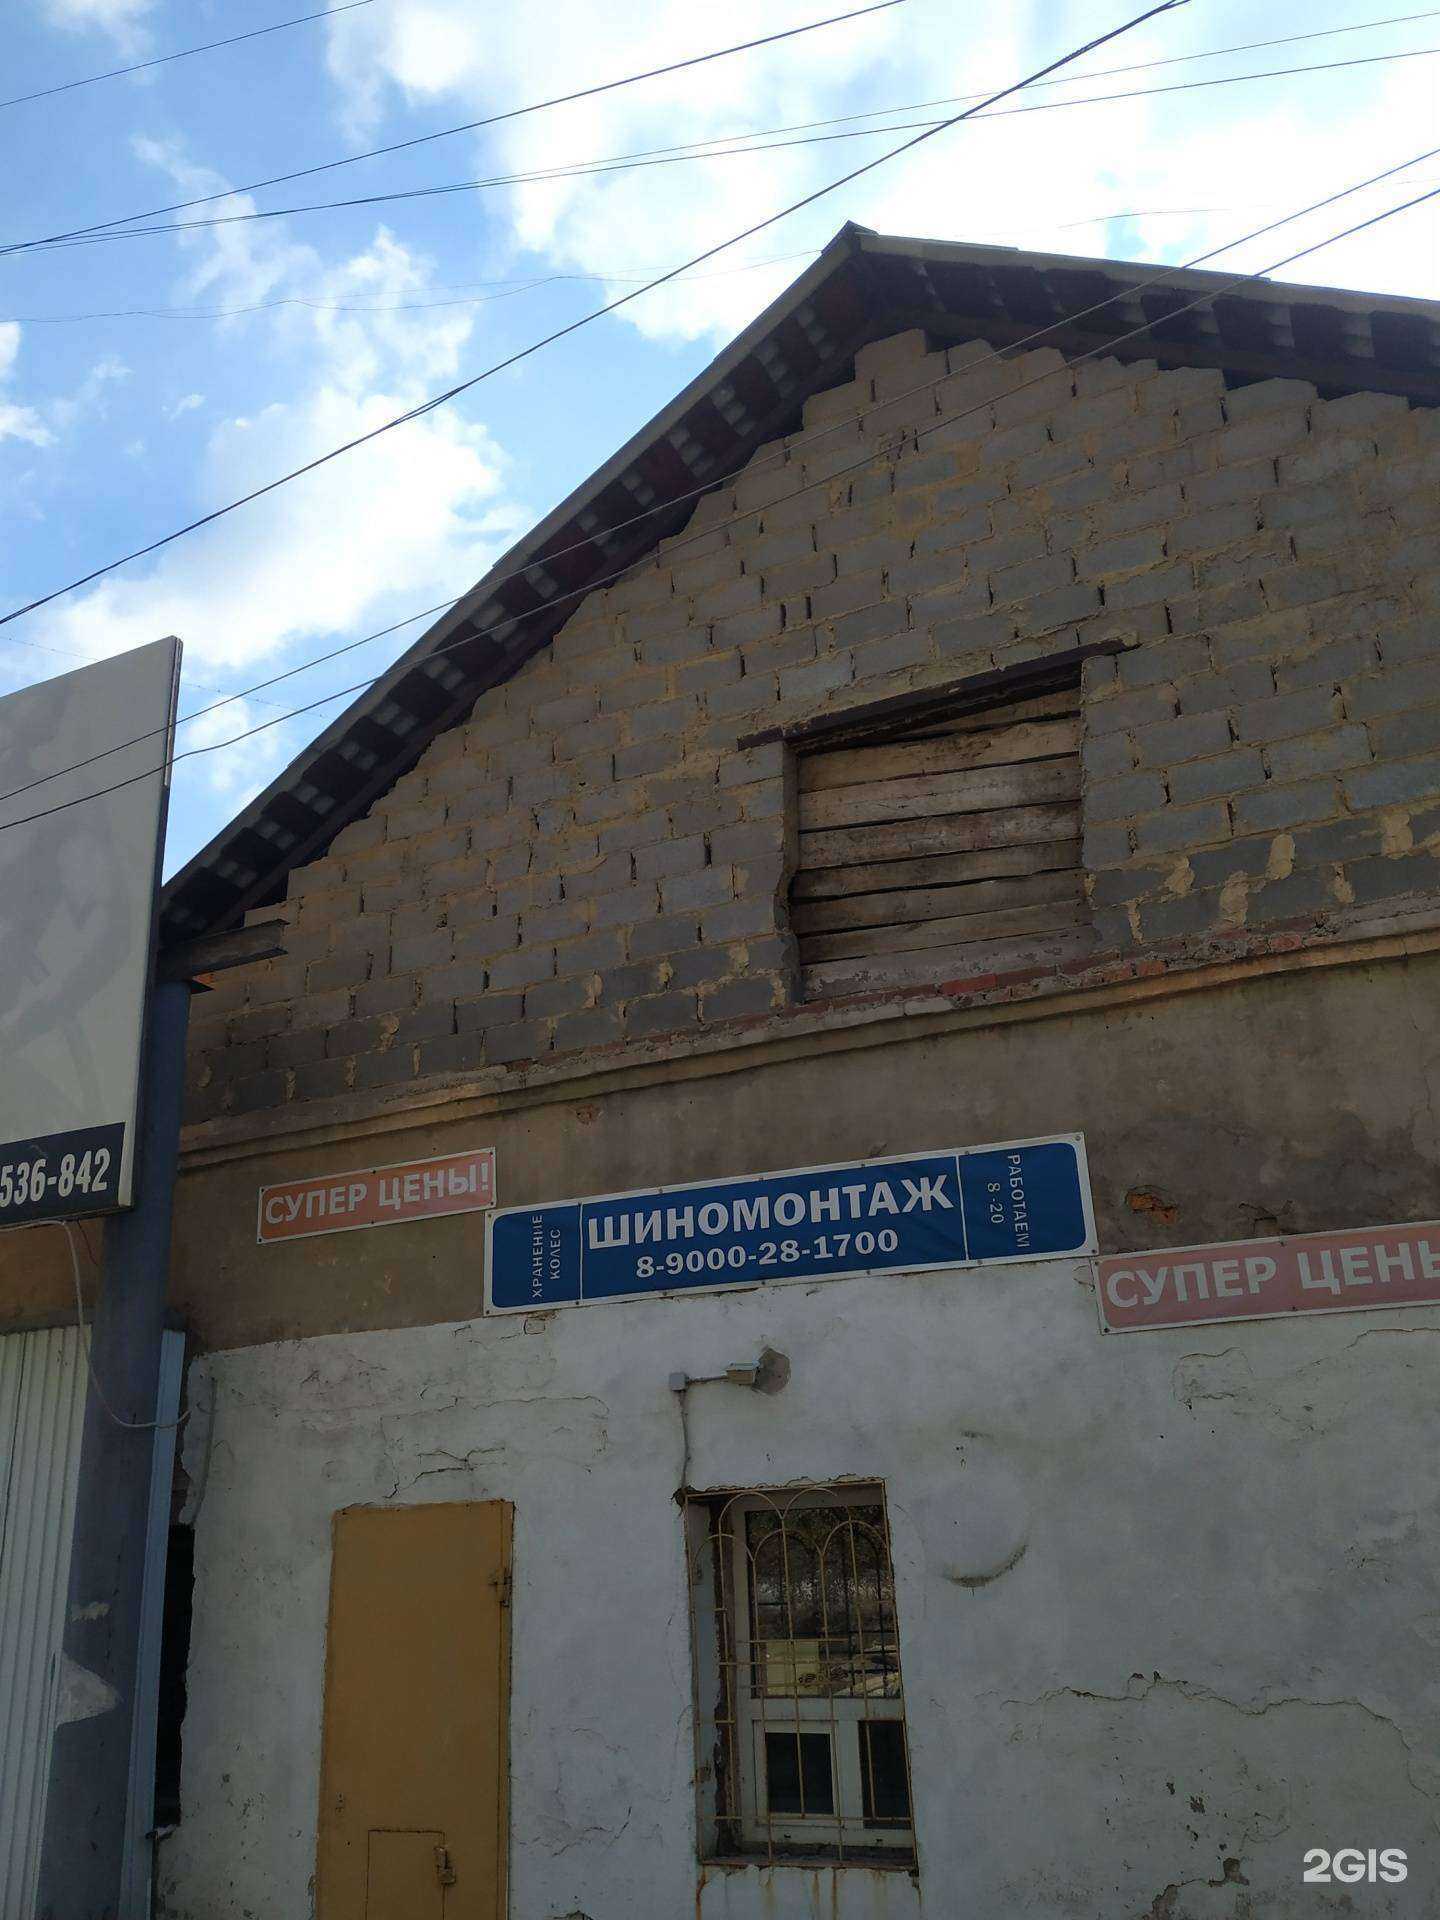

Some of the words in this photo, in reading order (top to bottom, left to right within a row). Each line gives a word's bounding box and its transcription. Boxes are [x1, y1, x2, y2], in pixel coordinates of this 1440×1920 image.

[0, 1147, 111, 1208] 536-842
[265, 1182, 368, 1225] СУПЕР
[378, 1162, 489, 1210] ЦЕНЫ!
[1007, 1154, 1030, 1248] РАБОТАЕМ
[588, 1174, 954, 1250] ШИНОМОНТАЖ
[531, 1214, 543, 1298] ХРАНЕНИЕ
[549, 1228, 561, 1280] КОЛЕС
[635, 1228, 899, 1279] 8-9000-28-1700
[1105, 1256, 1277, 1308] СУПЕР
